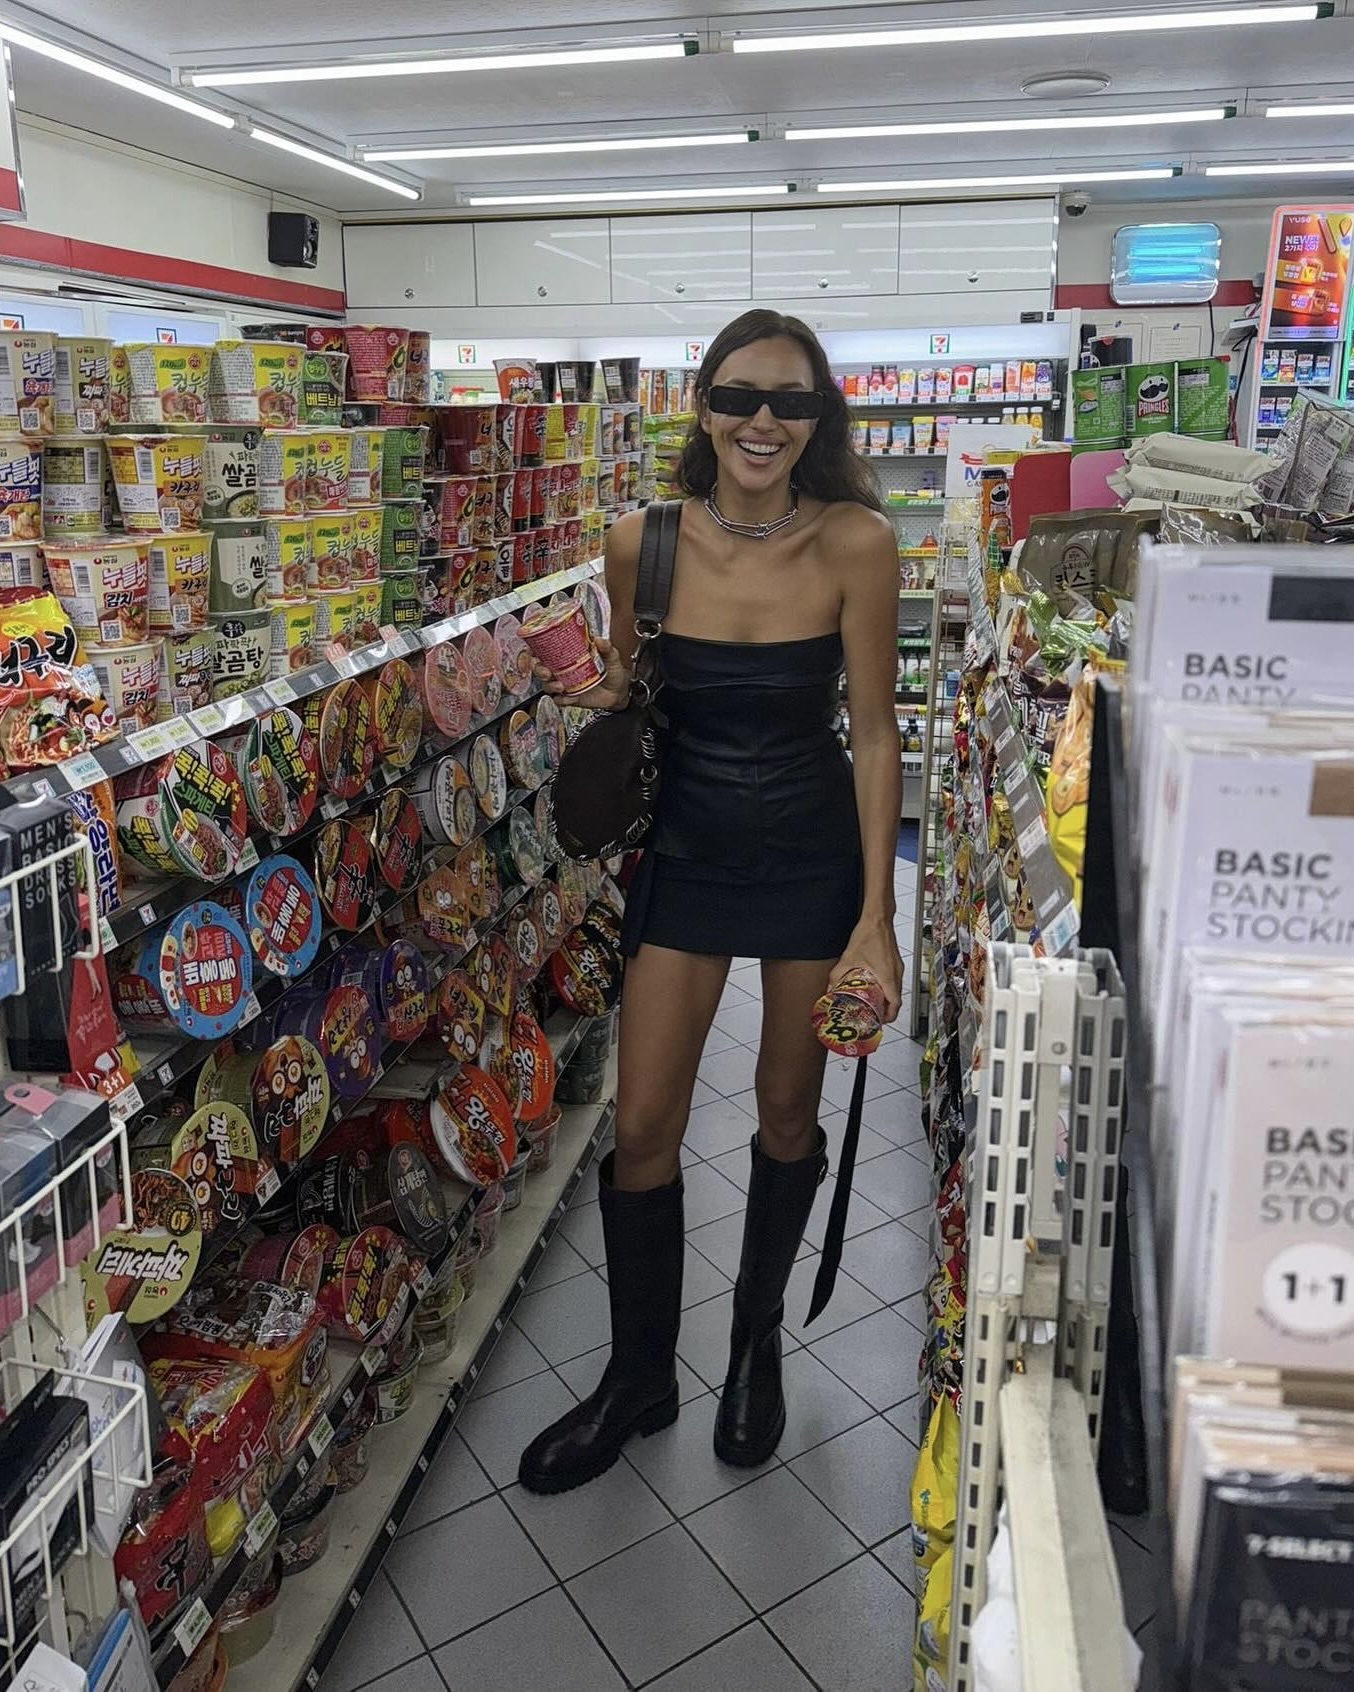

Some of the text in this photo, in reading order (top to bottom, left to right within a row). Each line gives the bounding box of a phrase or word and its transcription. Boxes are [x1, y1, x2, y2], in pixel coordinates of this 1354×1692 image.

[23, 350, 56, 377] 누들
[268, 371, 302, 394] 컵누
[1138, 399, 1170, 417] PRINGLES
[222, 463, 260, 488] 쌀곰
[106, 592, 133, 609] 김치
[1184, 653, 1288, 681] BASIC
[20, 811, 73, 851] MEN'S
[1214, 849, 1334, 881] BASIC
[1209, 880, 1342, 915] PANTY
[103, 1072, 125, 1095] 3+1
[1266, 1125, 1354, 1155] BAS
[1262, 1160, 1354, 1191] PAN
[170, 1209, 191, 1232] 40
[95, 1240, 190, 1282] 짜파게티
[1282, 1272, 1347, 1304] 1+1
